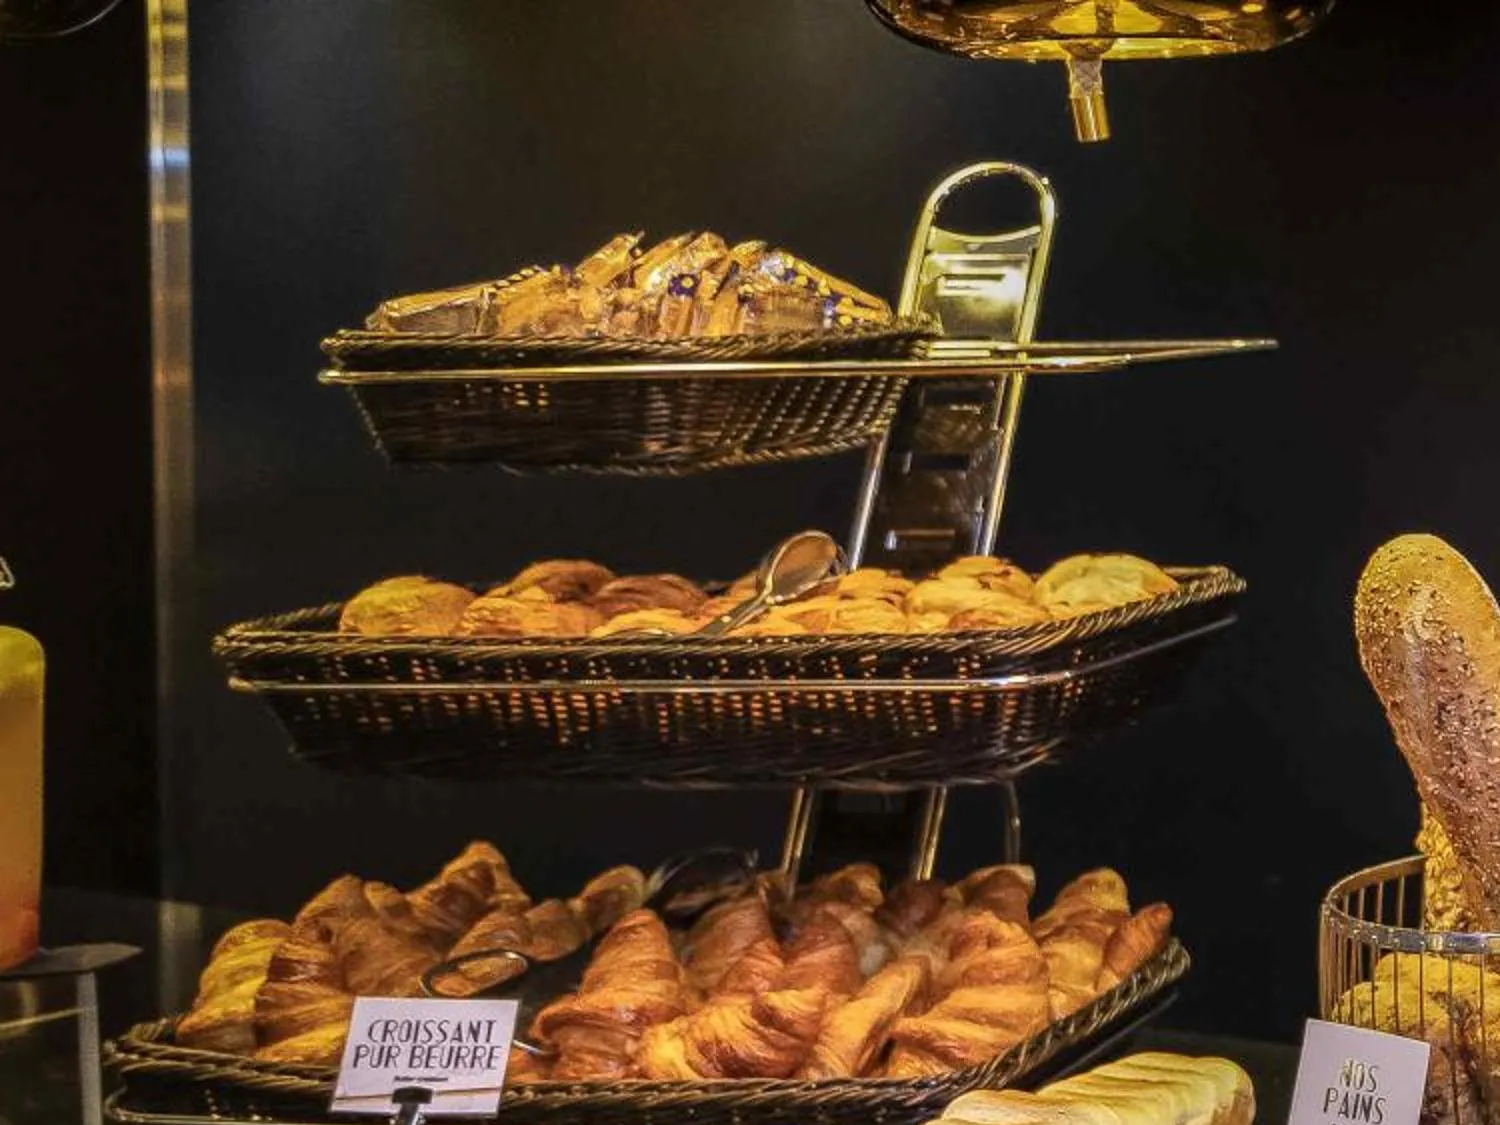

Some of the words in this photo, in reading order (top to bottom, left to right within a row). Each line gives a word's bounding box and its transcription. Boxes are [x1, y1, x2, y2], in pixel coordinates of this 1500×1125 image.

[366, 1018, 498, 1044] CROISSANT
[352, 1043, 400, 1069] PUR
[408, 1044, 502, 1070] BEURRE
[1340, 1059, 1380, 1093] NOS
[1323, 1087, 1388, 1125] PAINS
